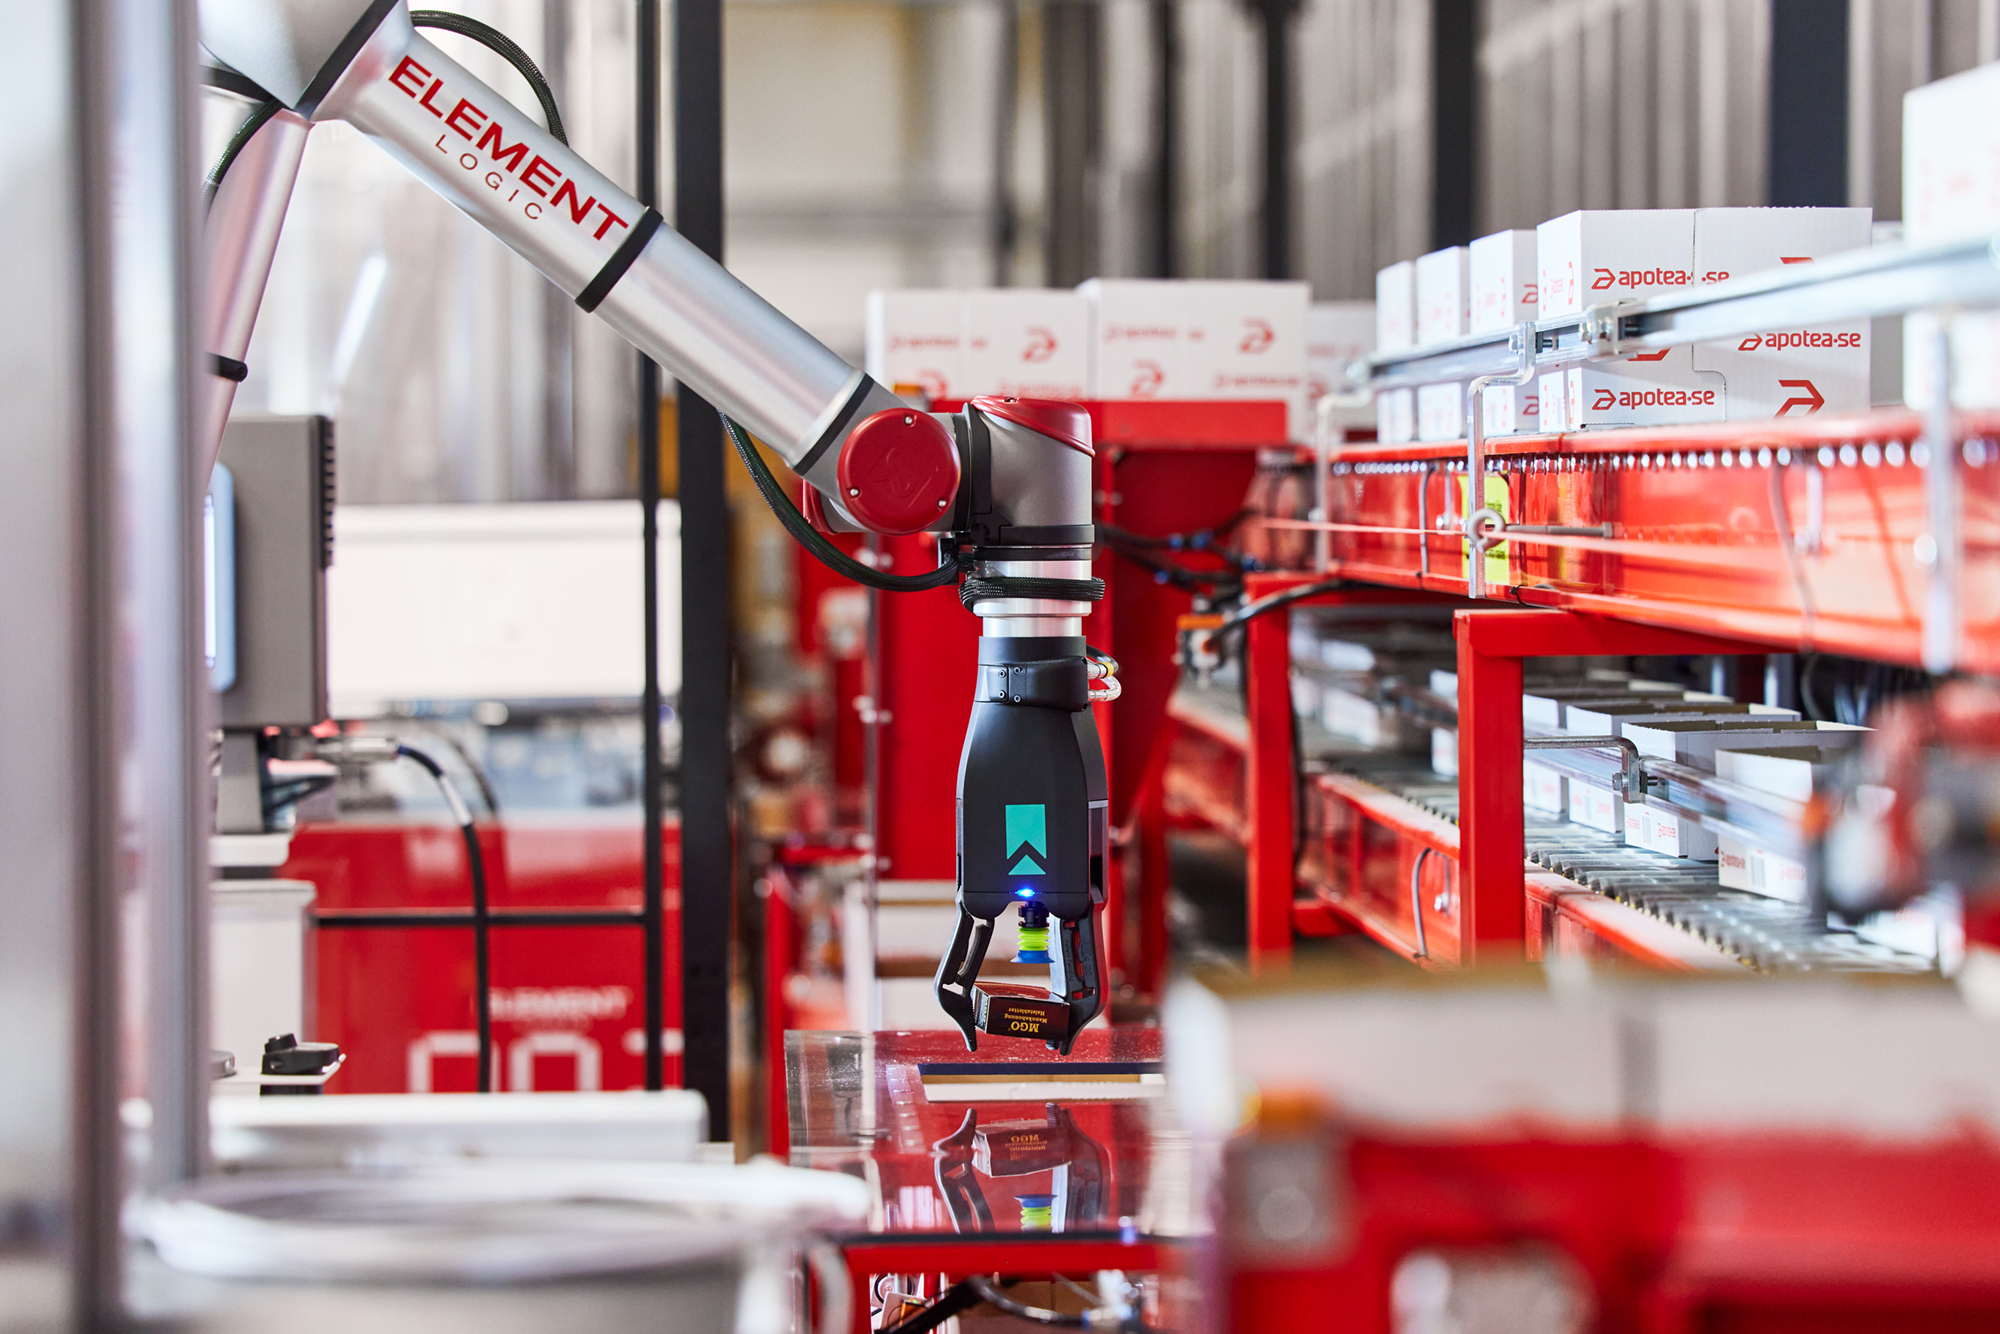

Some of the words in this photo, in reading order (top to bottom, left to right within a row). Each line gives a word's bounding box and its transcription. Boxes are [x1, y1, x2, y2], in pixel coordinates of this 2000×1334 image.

[388, 55, 629, 241] ELEMENT
[435, 134, 543, 220] LOGIC
[1004, 1013, 1048, 1024] Manukahonung
